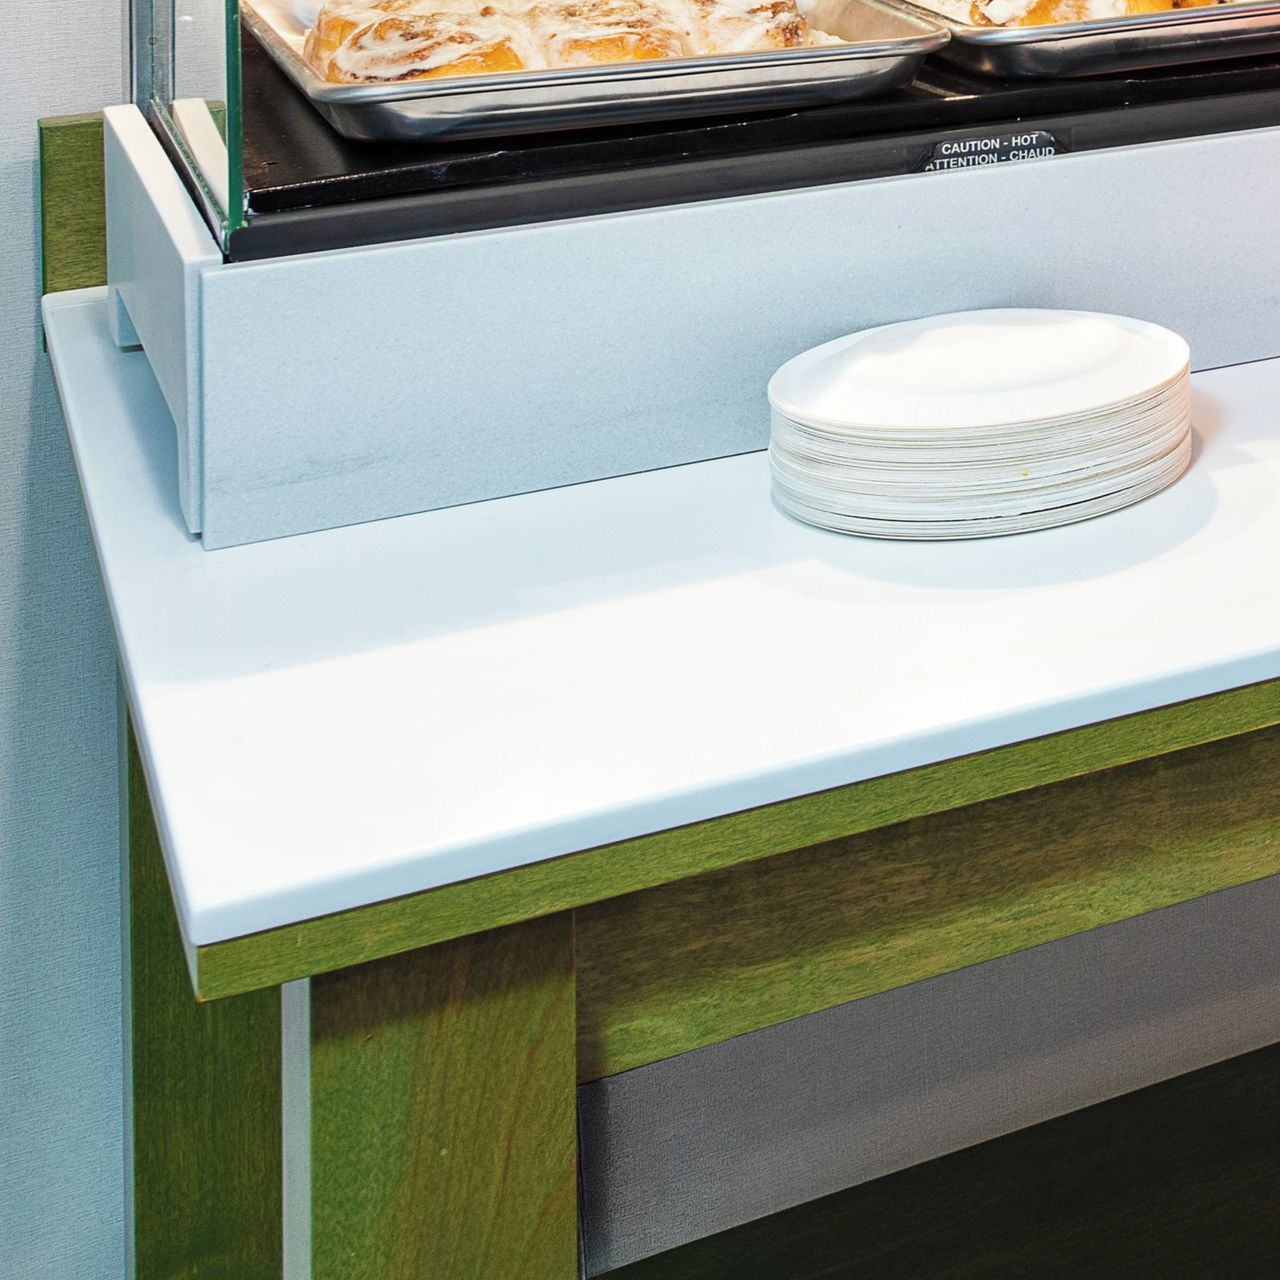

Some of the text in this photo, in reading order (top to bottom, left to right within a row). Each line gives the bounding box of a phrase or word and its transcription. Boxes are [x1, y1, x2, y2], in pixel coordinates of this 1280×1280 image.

[941, 138, 1000, 155] CAUTION
[1011, 134, 1039, 147] HOT
[1009, 146, 1055, 161] CHAUD
